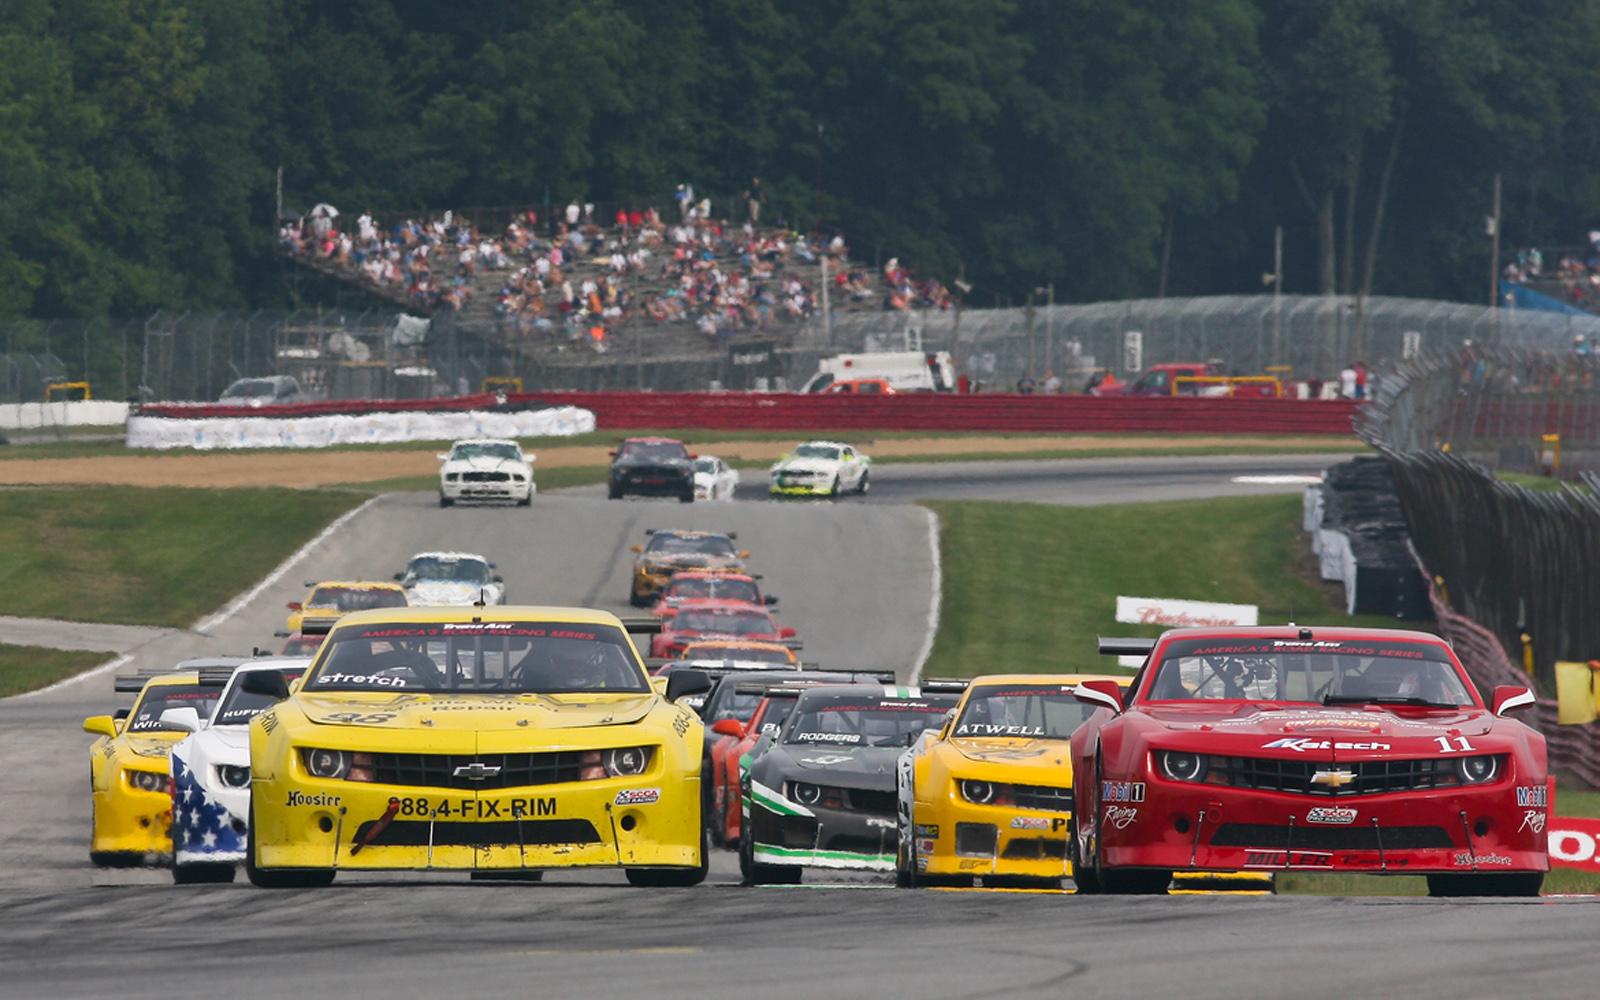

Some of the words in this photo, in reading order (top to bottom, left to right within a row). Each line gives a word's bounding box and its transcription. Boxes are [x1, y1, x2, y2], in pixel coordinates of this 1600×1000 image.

[360, 629, 437, 637] AMERICA'S
[490, 629, 545, 637] RACING
[550, 631, 597, 640] SERIES
[1193, 646, 1269, 654] AMERICA'S
[1319, 646, 1374, 655] RACING
[1380, 649, 1424, 659] SERIES
[318, 672, 406, 688] stretch
[956, 724, 1045, 736] ATWELL
[798, 732, 861, 743] RODGERS
[1433, 736, 1477, 753] 11
[1276, 738, 1391, 752] Katech
[629, 789, 658, 797] SCCA
[1102, 781, 1131, 802] Mobil
[285, 791, 341, 807] Hoosier
[388, 796, 556, 818] 8884-FIX-RIM
[1322, 809, 1353, 817] SCCA
[1247, 853, 1329, 865] MILER
[1343, 854, 1409, 867] Racng
